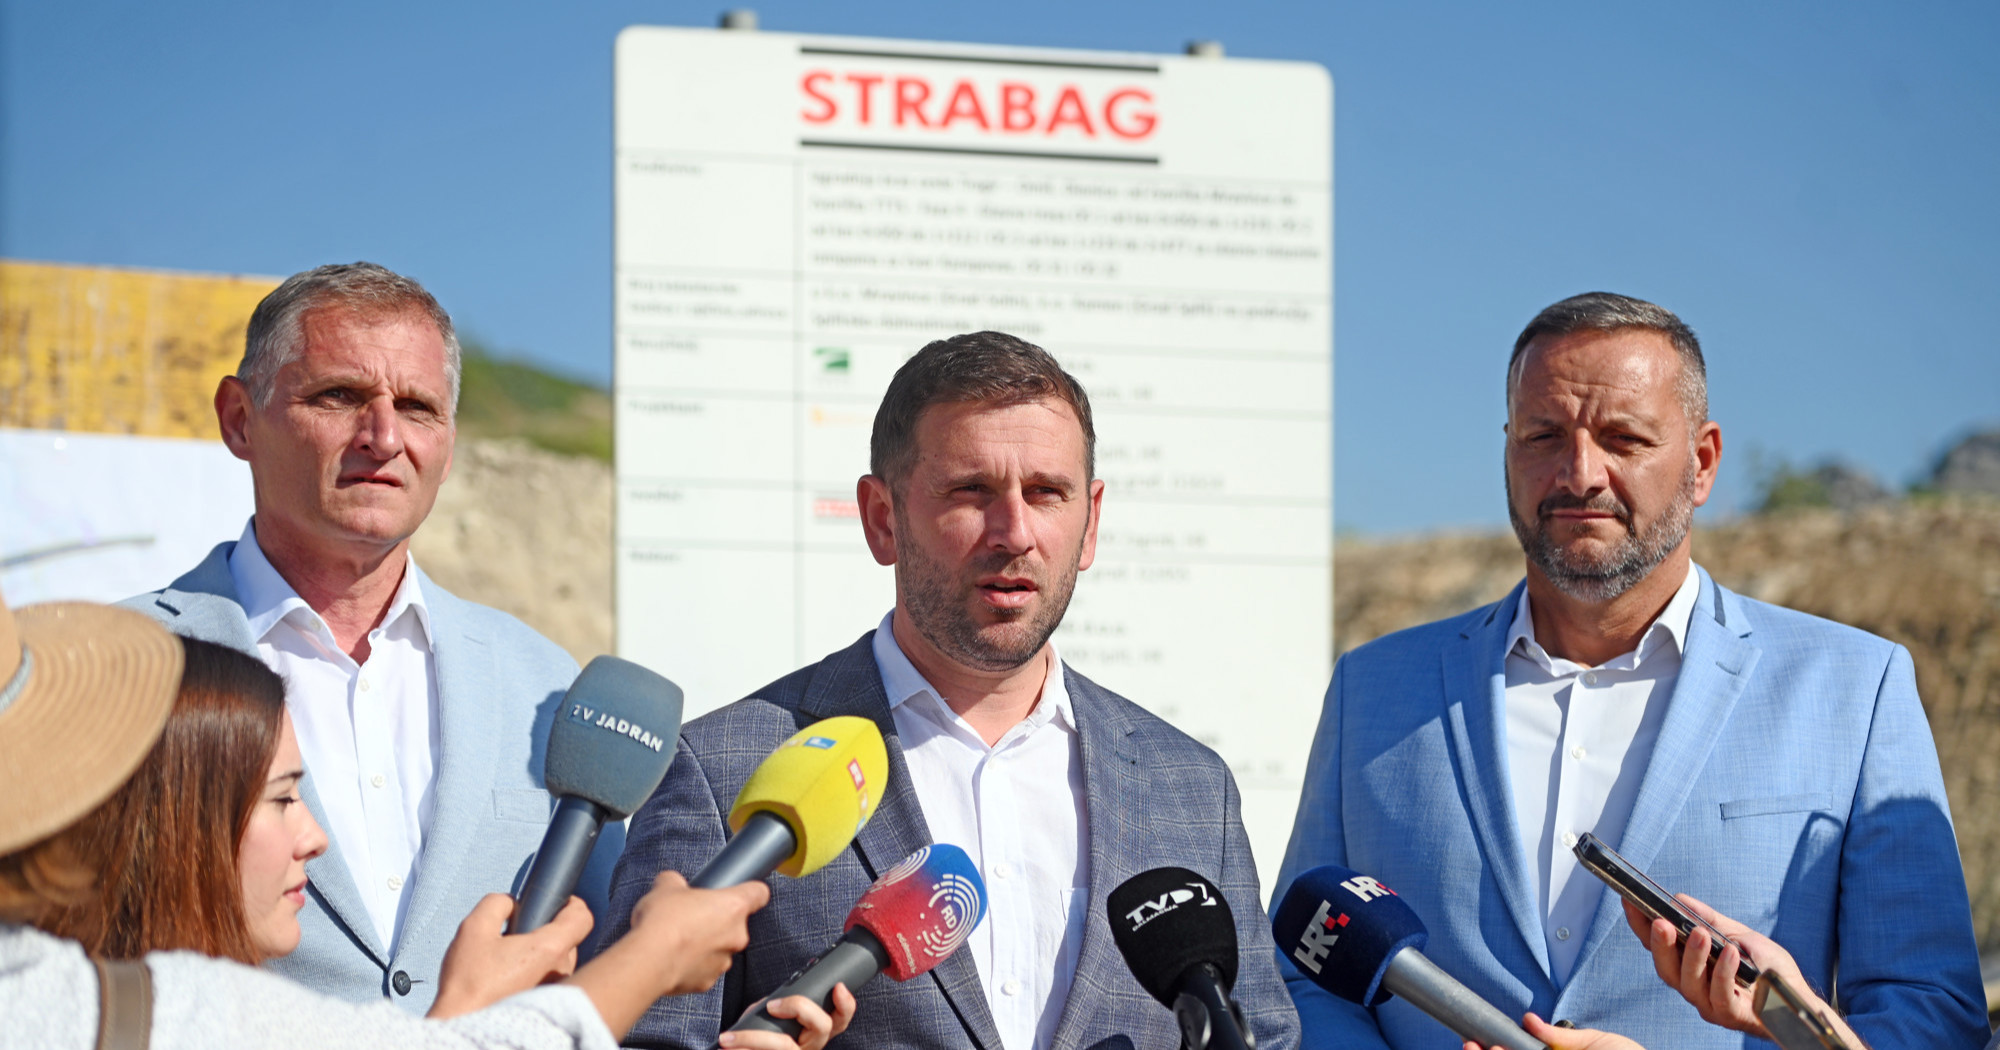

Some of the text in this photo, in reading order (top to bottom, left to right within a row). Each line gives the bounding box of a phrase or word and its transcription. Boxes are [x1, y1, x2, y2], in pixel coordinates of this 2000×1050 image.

[801, 71, 1158, 140] STRABAG
[596, 713, 663, 752] JADRAN
[941, 904, 957, 929] RD
[1294, 899, 1350, 975] HRT
